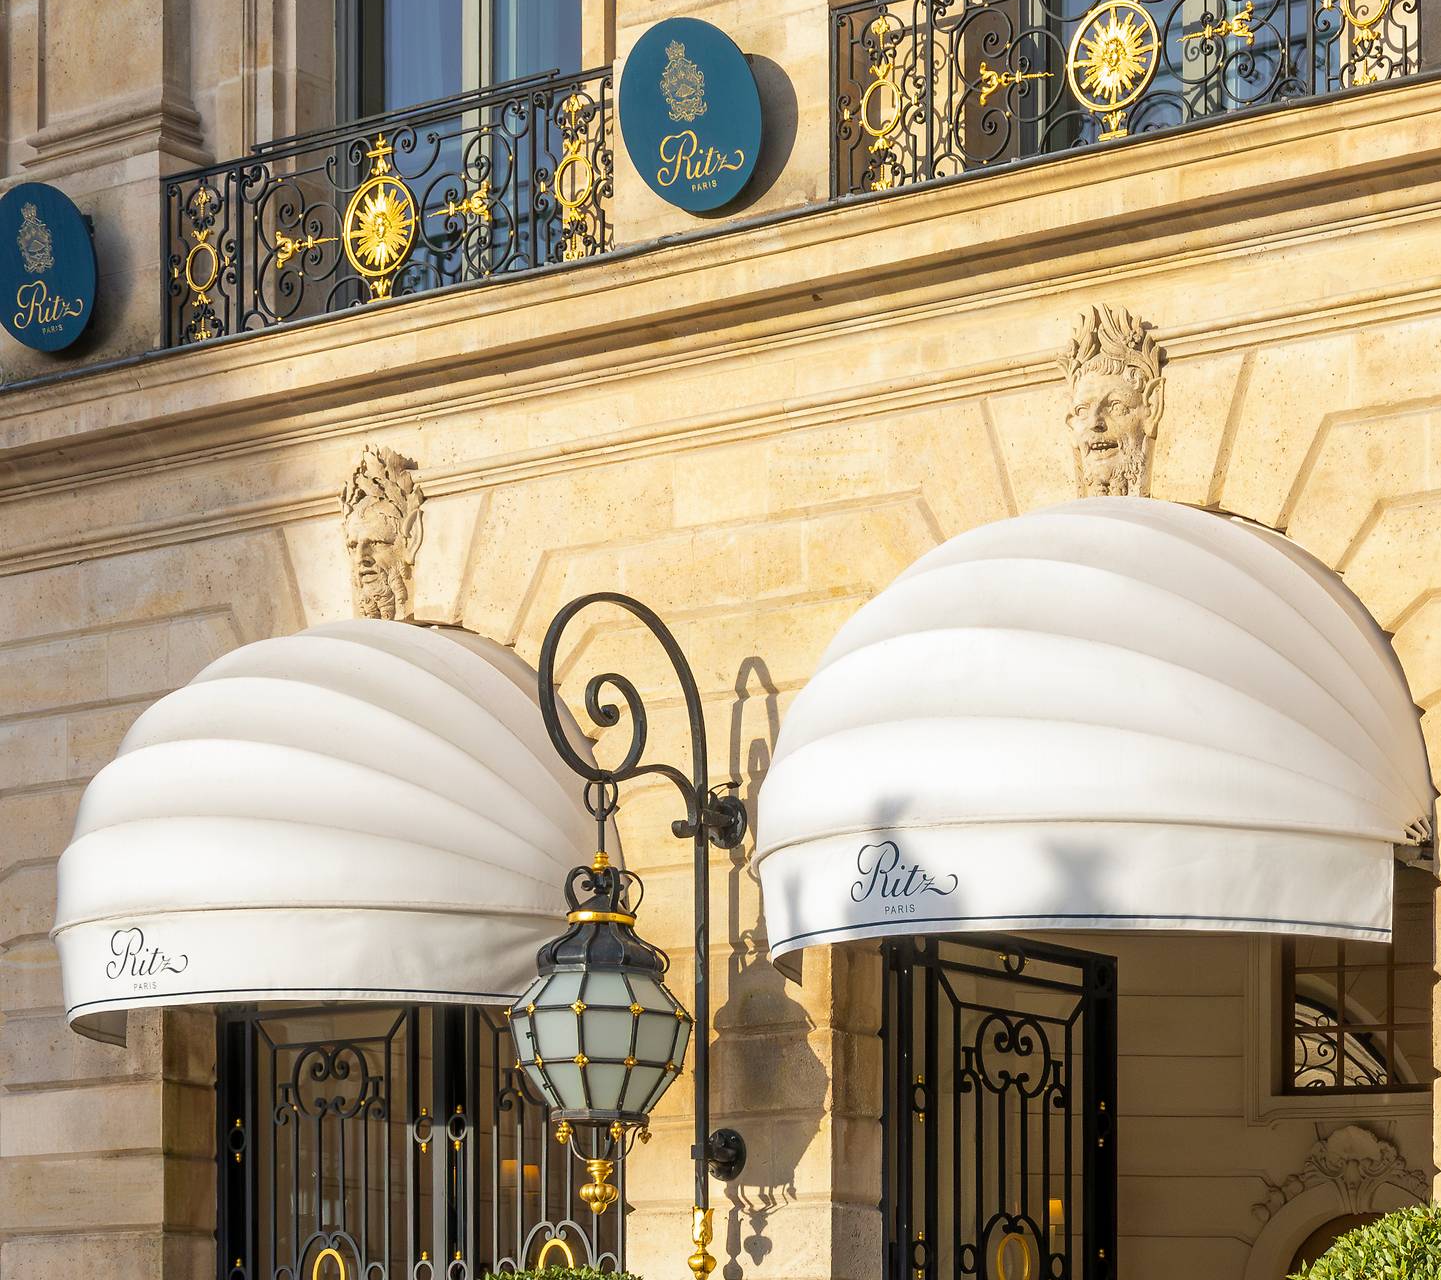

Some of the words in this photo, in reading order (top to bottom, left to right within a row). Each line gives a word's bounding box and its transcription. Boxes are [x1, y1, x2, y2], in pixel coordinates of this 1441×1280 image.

[656, 129, 745, 187] Ritz
[691, 179, 718, 193] PARIS
[13, 279, 84, 329] Ritz
[850, 840, 959, 903] Ritz
[884, 903, 916, 915] PARIS
[106, 927, 189, 980] Ritz
[133, 981, 158, 991] PARIS
